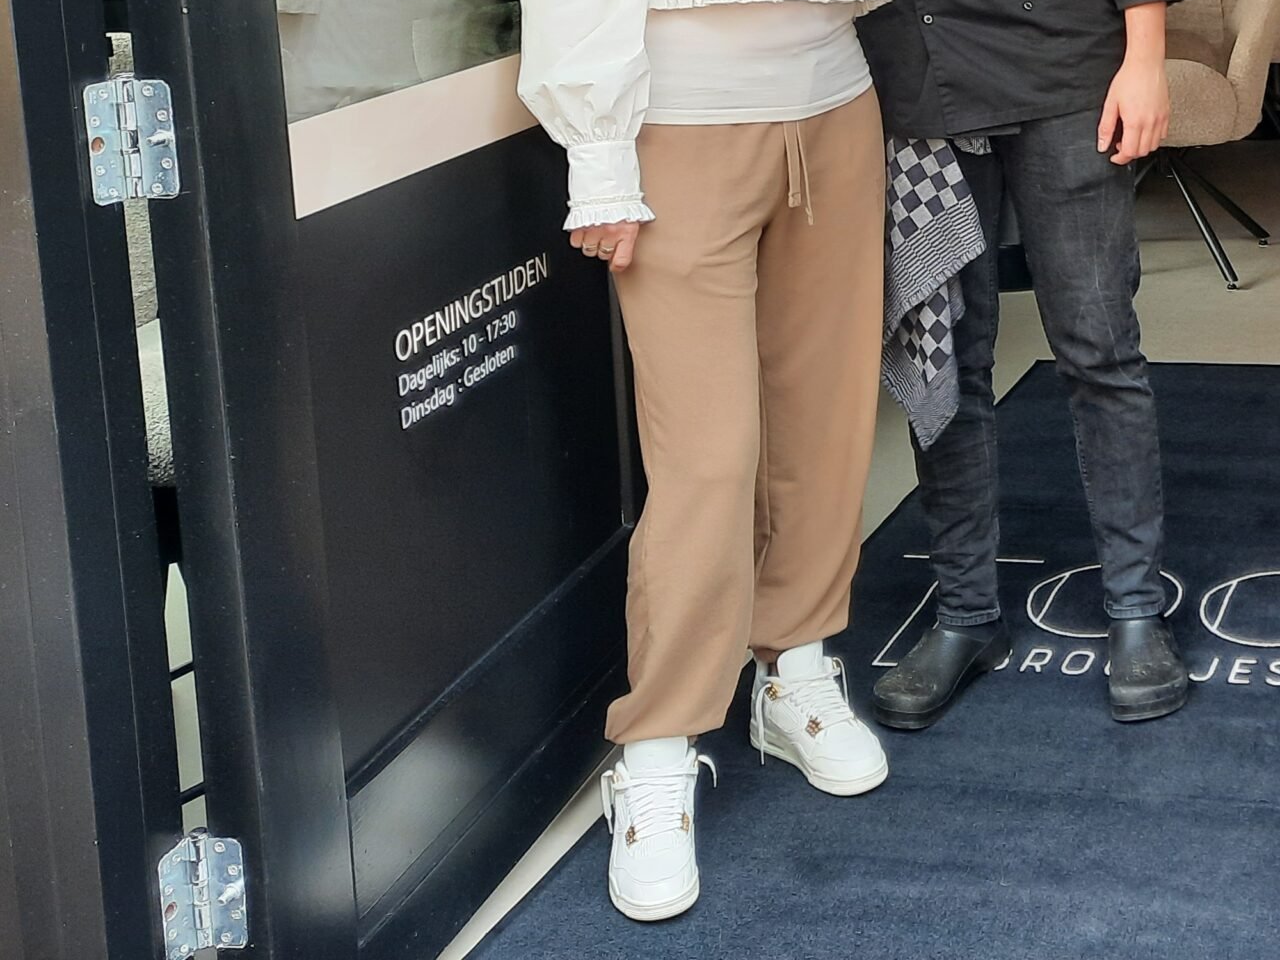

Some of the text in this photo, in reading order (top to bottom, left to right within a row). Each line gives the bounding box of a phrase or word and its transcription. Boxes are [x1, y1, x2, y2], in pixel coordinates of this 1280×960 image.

[394, 252, 548, 362] OPENINGSTIJDEN
[398, 348, 461, 397] Dagelijks:
[461, 333, 477, 357] 10
[485, 309, 517, 343] 17:30
[400, 383, 455, 431] Dinsdag
[463, 344, 516, 388] Gesloten
